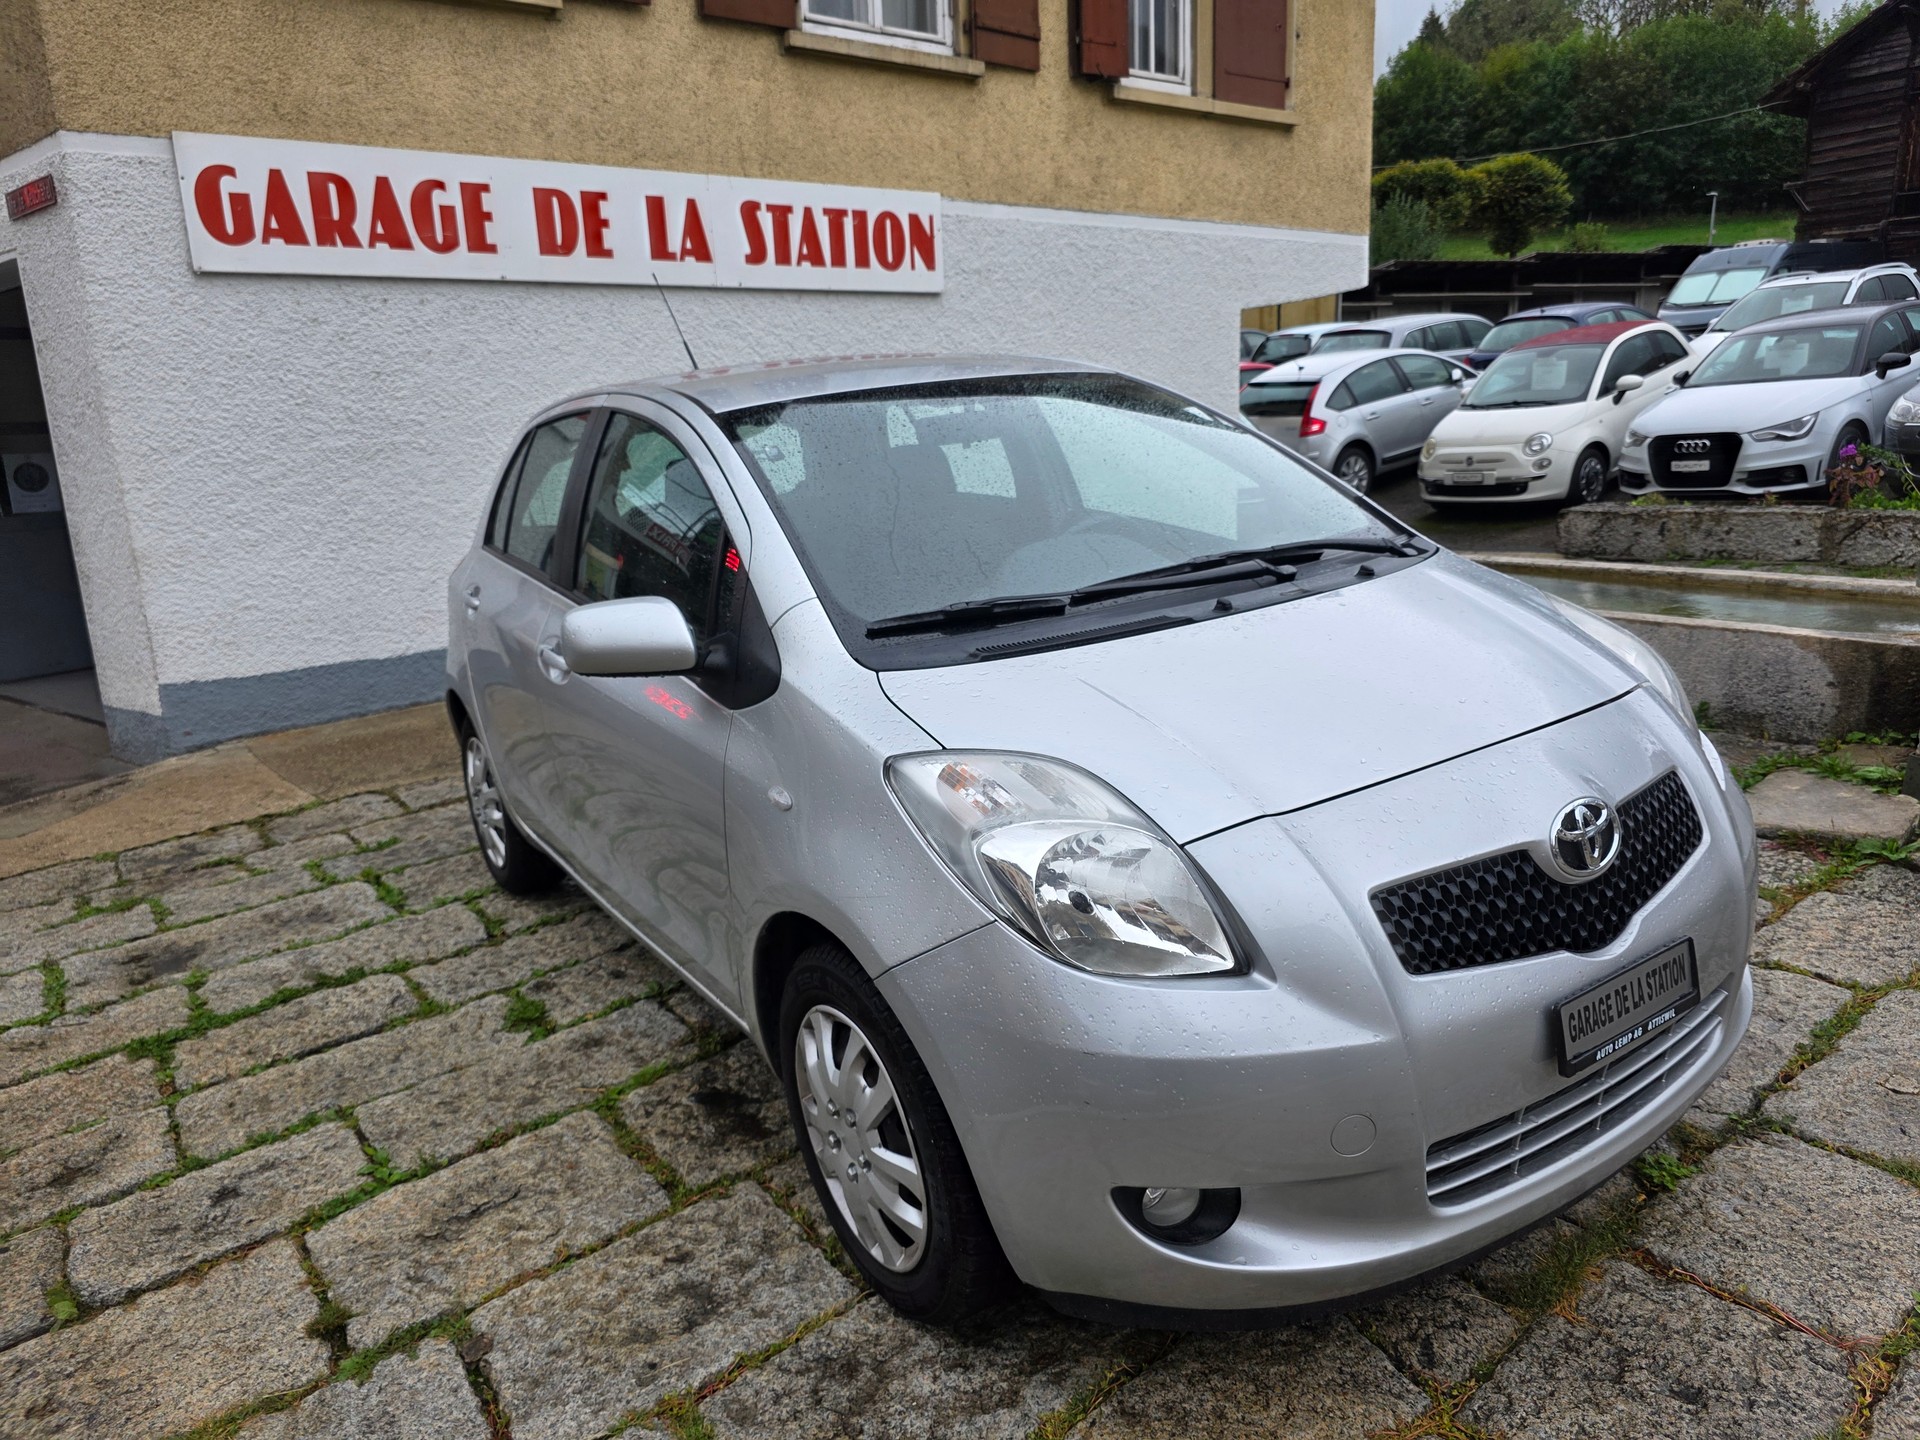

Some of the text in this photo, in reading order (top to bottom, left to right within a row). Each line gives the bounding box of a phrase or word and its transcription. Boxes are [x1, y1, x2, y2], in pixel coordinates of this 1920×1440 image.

[194, 163, 936, 272] GARAGE DE LA STATION
[1568, 953, 1686, 1043] GARAGE DE LA STATION
[1596, 1008, 1676, 1061] AUTO LEMP AG ATTISWIL
